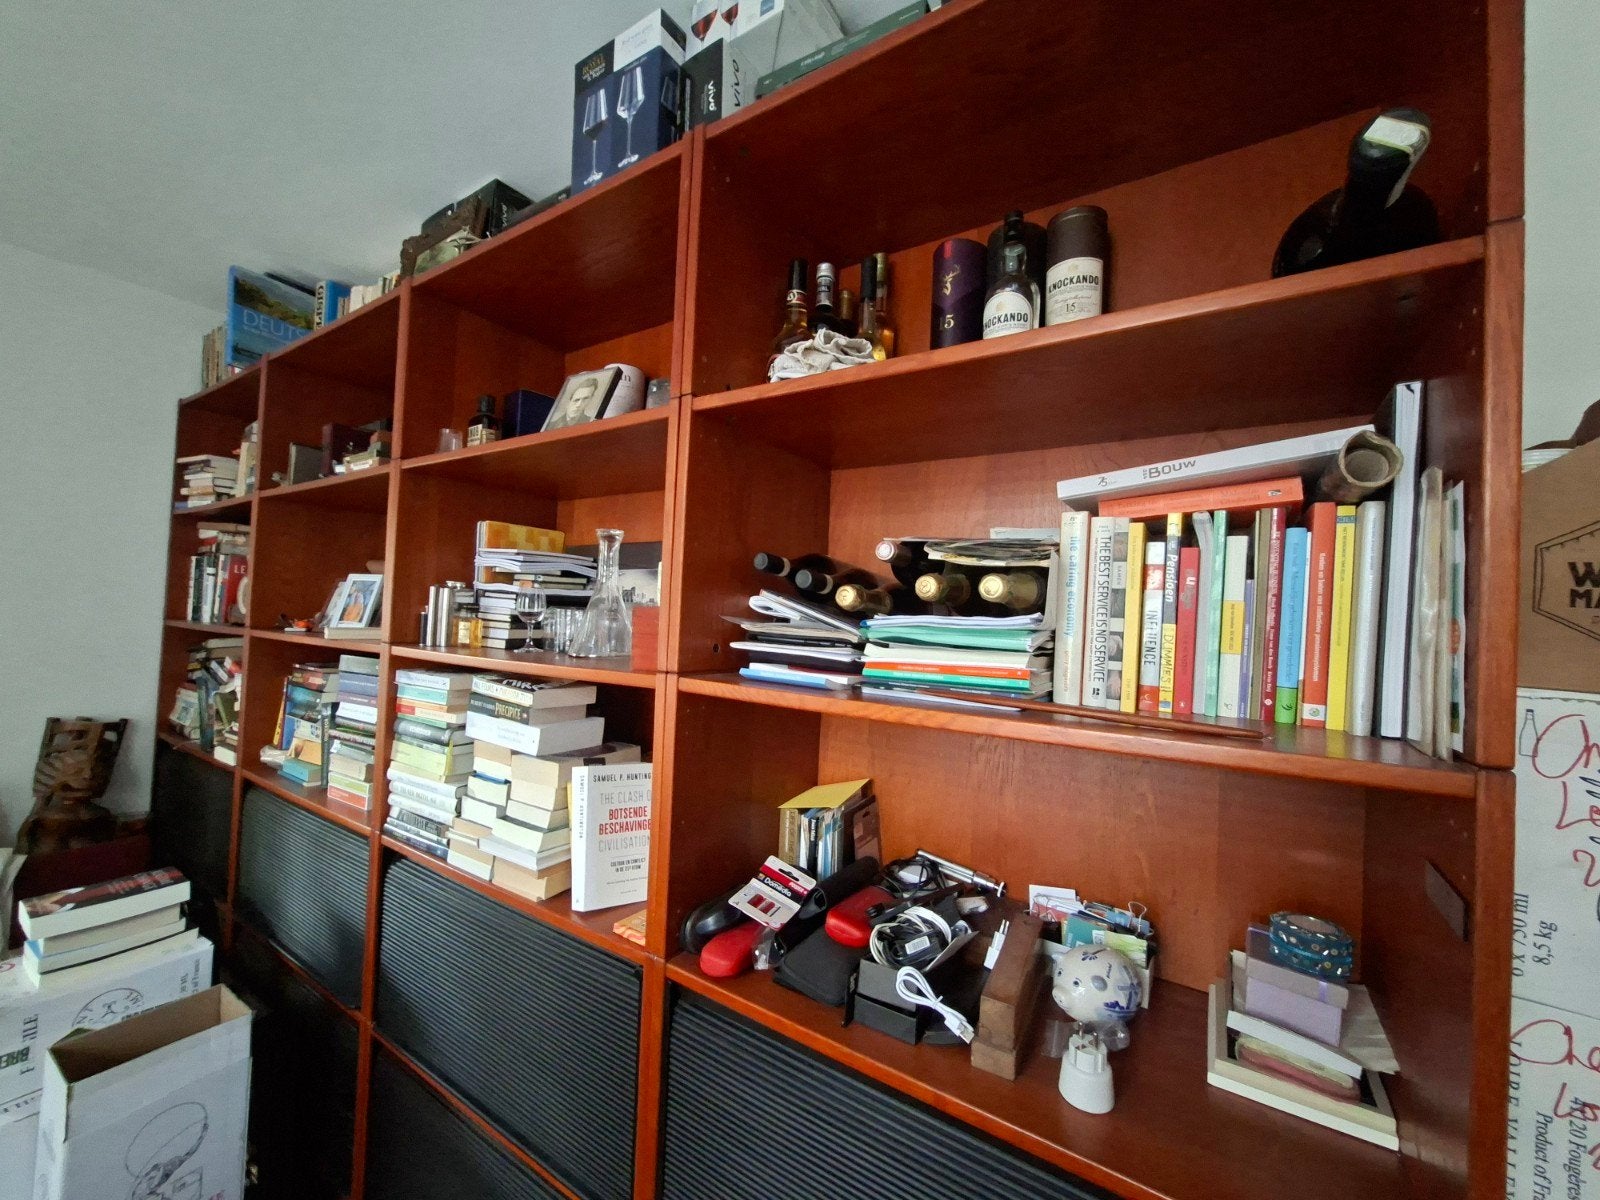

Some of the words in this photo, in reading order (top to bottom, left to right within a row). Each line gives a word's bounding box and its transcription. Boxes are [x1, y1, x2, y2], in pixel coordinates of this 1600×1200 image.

[731, 59, 741, 107] vivo
[1048, 274, 1099, 294] KNOCKANDO
[1065, 303, 1077, 313] 15
[983, 312, 1029, 330] NOCKANDO
[1070, 536, 1081, 552] the
[1099, 536, 1112, 555] THE
[1066, 555, 1079, 588] caring
[1098, 555, 1110, 579] BEST
[1165, 554, 1178, 603] Pensioen
[1096, 580, 1109, 619] SERVICE
[1064, 590, 1077, 637] economy
[1096, 619, 1107, 628] IS
[1095, 630, 1106, 644] NO
[1093, 644, 1106, 683] SERVICE
[1160, 634, 1175, 684] DUMMIES
[494, 702, 521, 720] PRECIPICE
[593, 774, 617, 783] SAMUEL
[600, 792, 615, 806] THE
[617, 790, 644, 804] CLASH
[608, 805, 648, 821] BOTSENDE
[1533, 920, 1558, 940] kg
[1532, 942, 1555, 966] 8,5
[1535, 1110, 1553, 1162] Product
[1534, 1165, 1552, 1183] of
